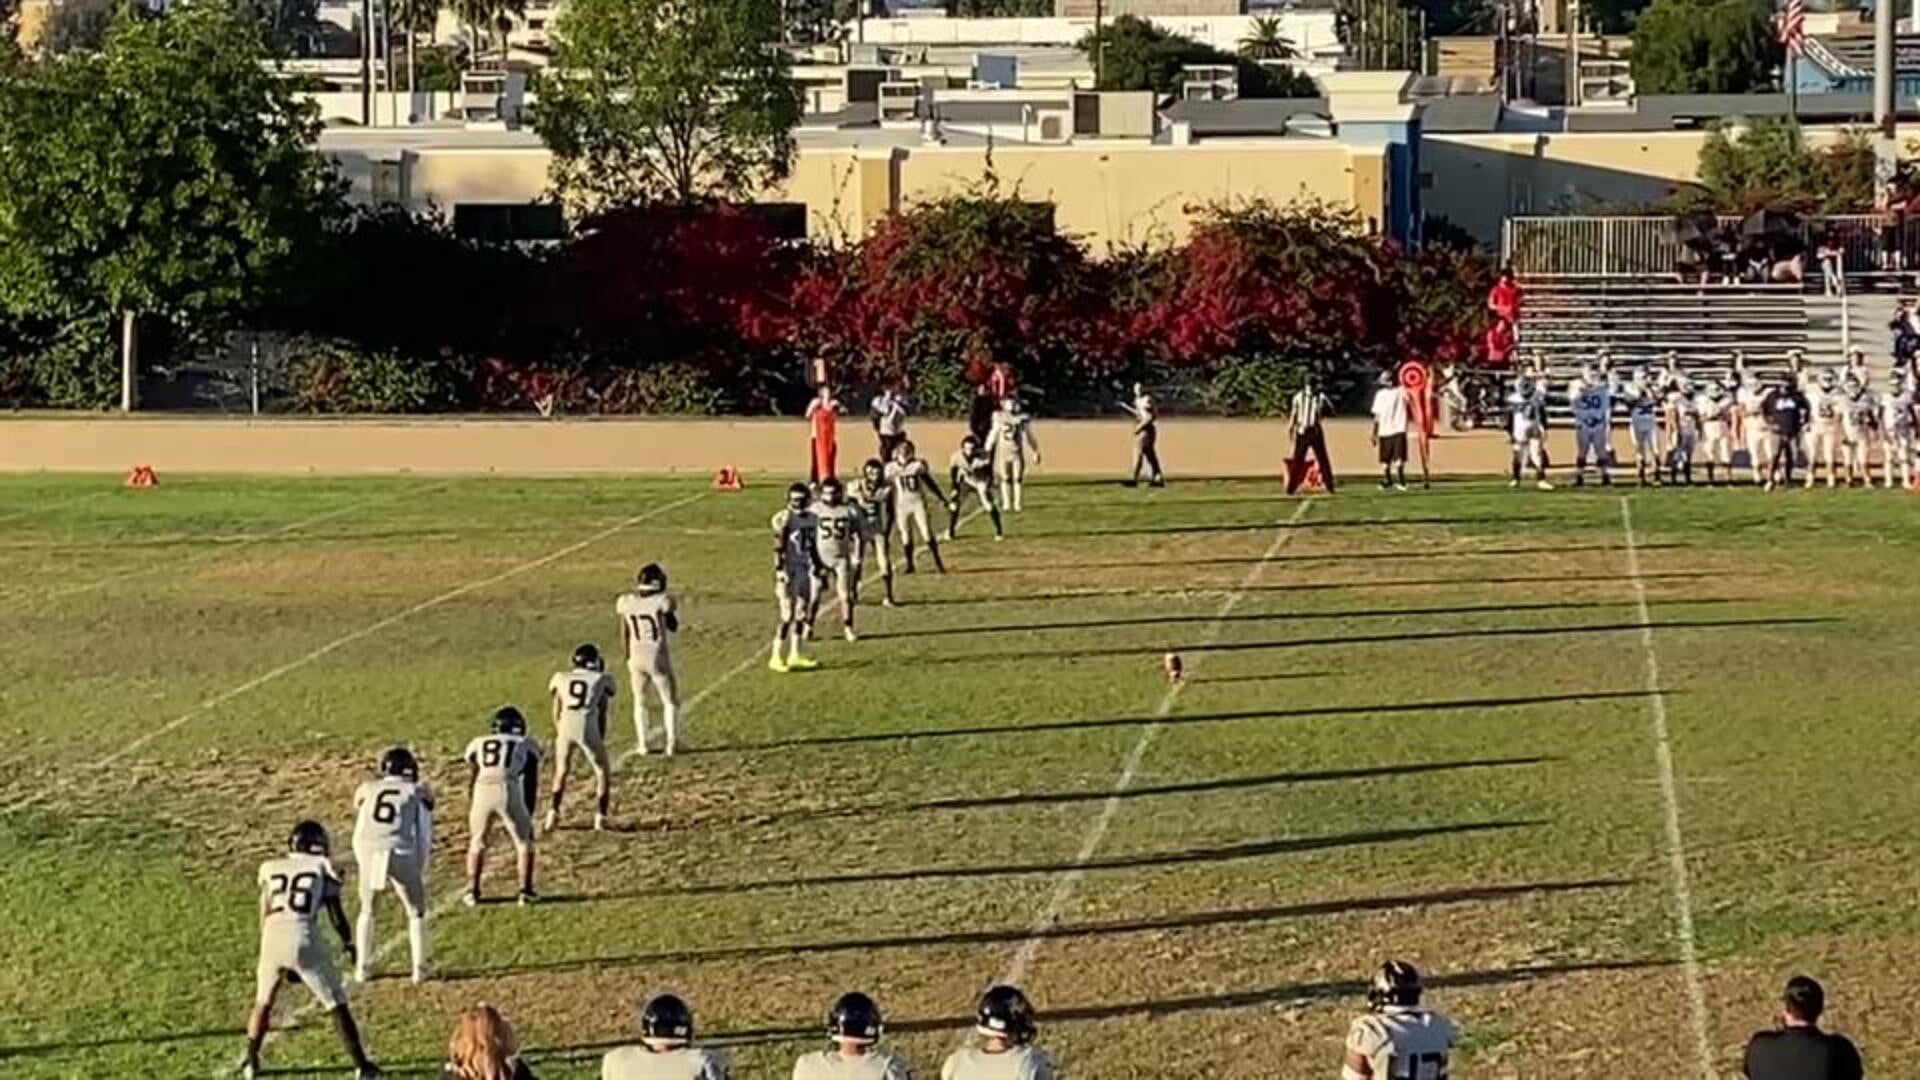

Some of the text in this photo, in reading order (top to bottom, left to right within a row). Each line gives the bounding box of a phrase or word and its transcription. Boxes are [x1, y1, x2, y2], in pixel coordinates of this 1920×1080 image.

[819, 517, 849, 540] 55
[568, 680, 588, 710] 9
[483, 739, 515, 768] 81
[373, 790, 401, 824] 6
[268, 872, 317, 914] 26
